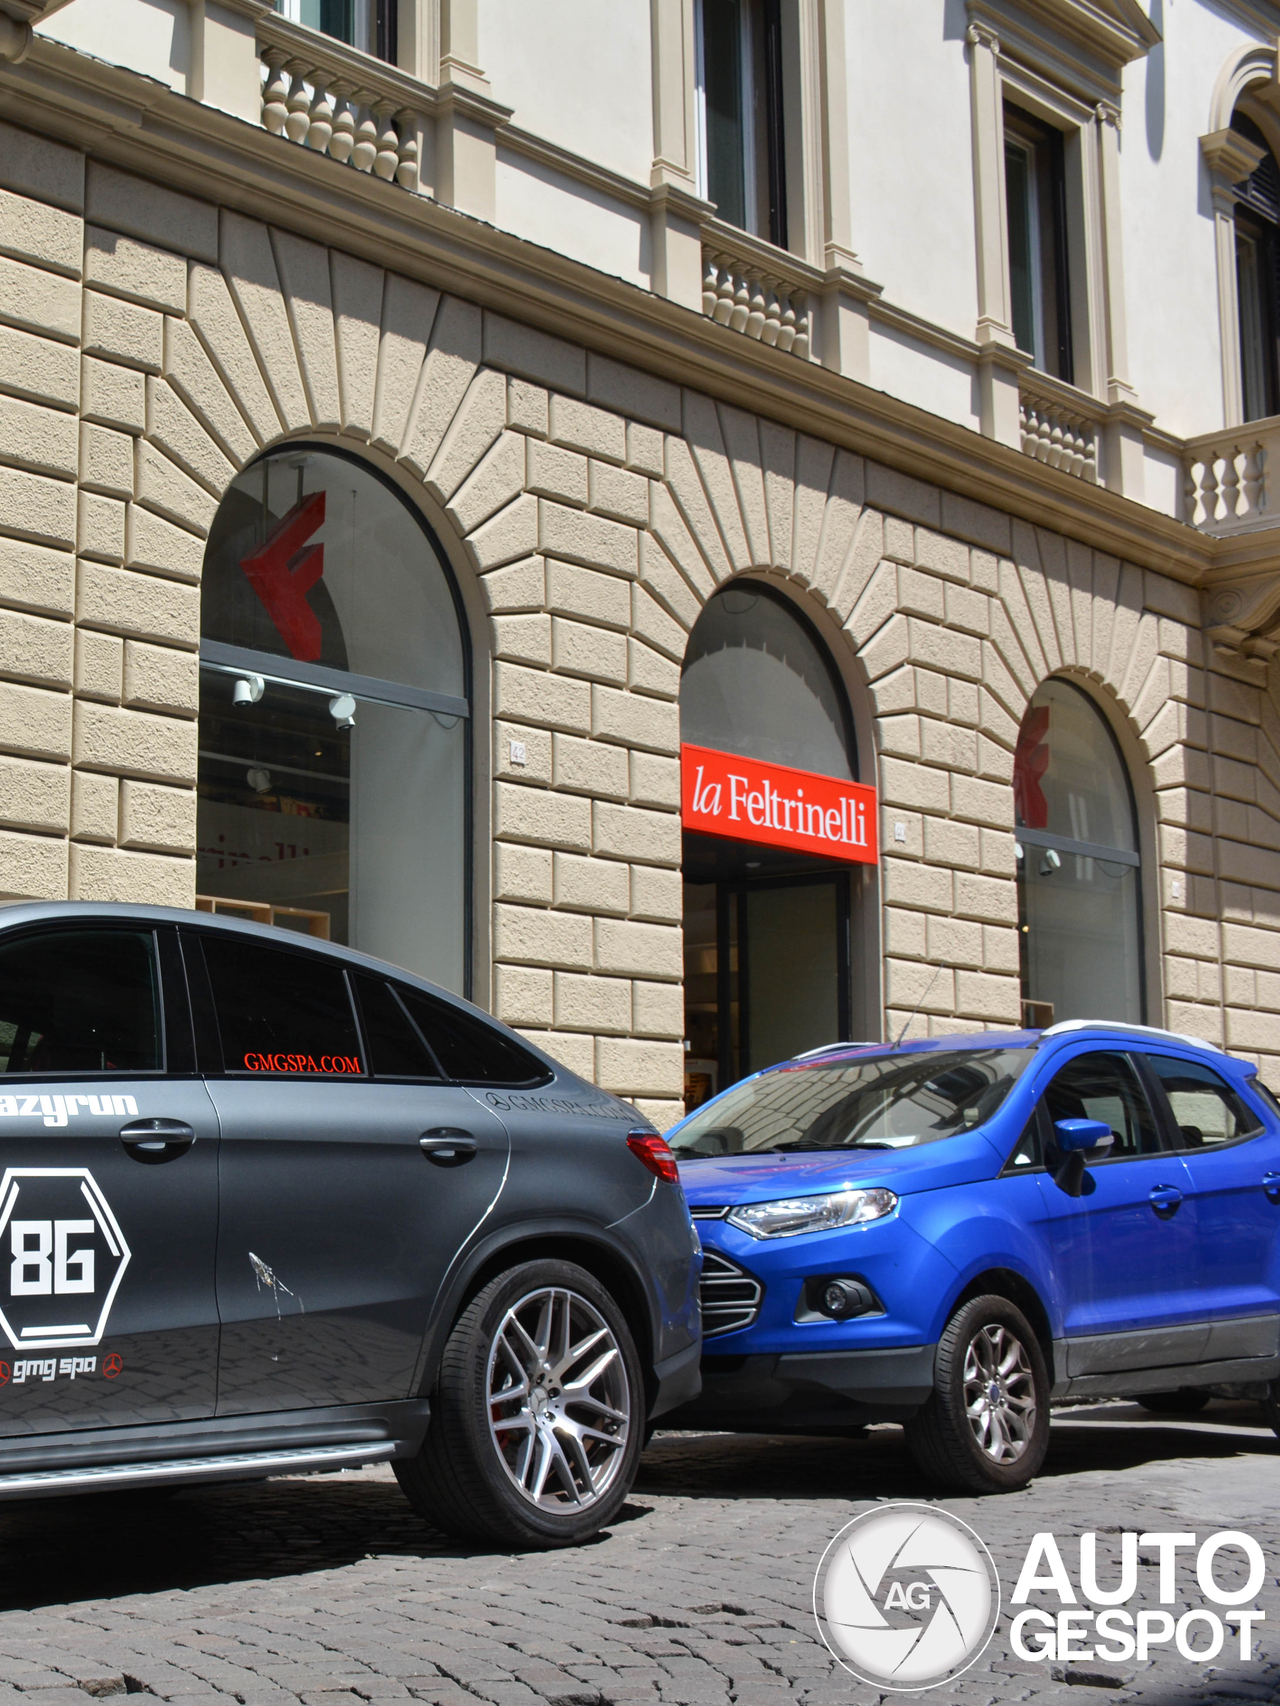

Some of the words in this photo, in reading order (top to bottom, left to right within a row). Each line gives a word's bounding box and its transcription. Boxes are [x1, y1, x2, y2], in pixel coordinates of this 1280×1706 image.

[512, 746, 525, 760] 42
[692, 765, 722, 816] la
[727, 774, 868, 847] Feltrinelli
[244, 1053, 362, 1074] GMGSPA.COM
[508, 1095, 635, 1122] GMGSPA.COM
[10, 1219, 95, 1296] 86
[13, 1359, 56, 1384] gmg
[58, 1355, 96, 1380] spa
